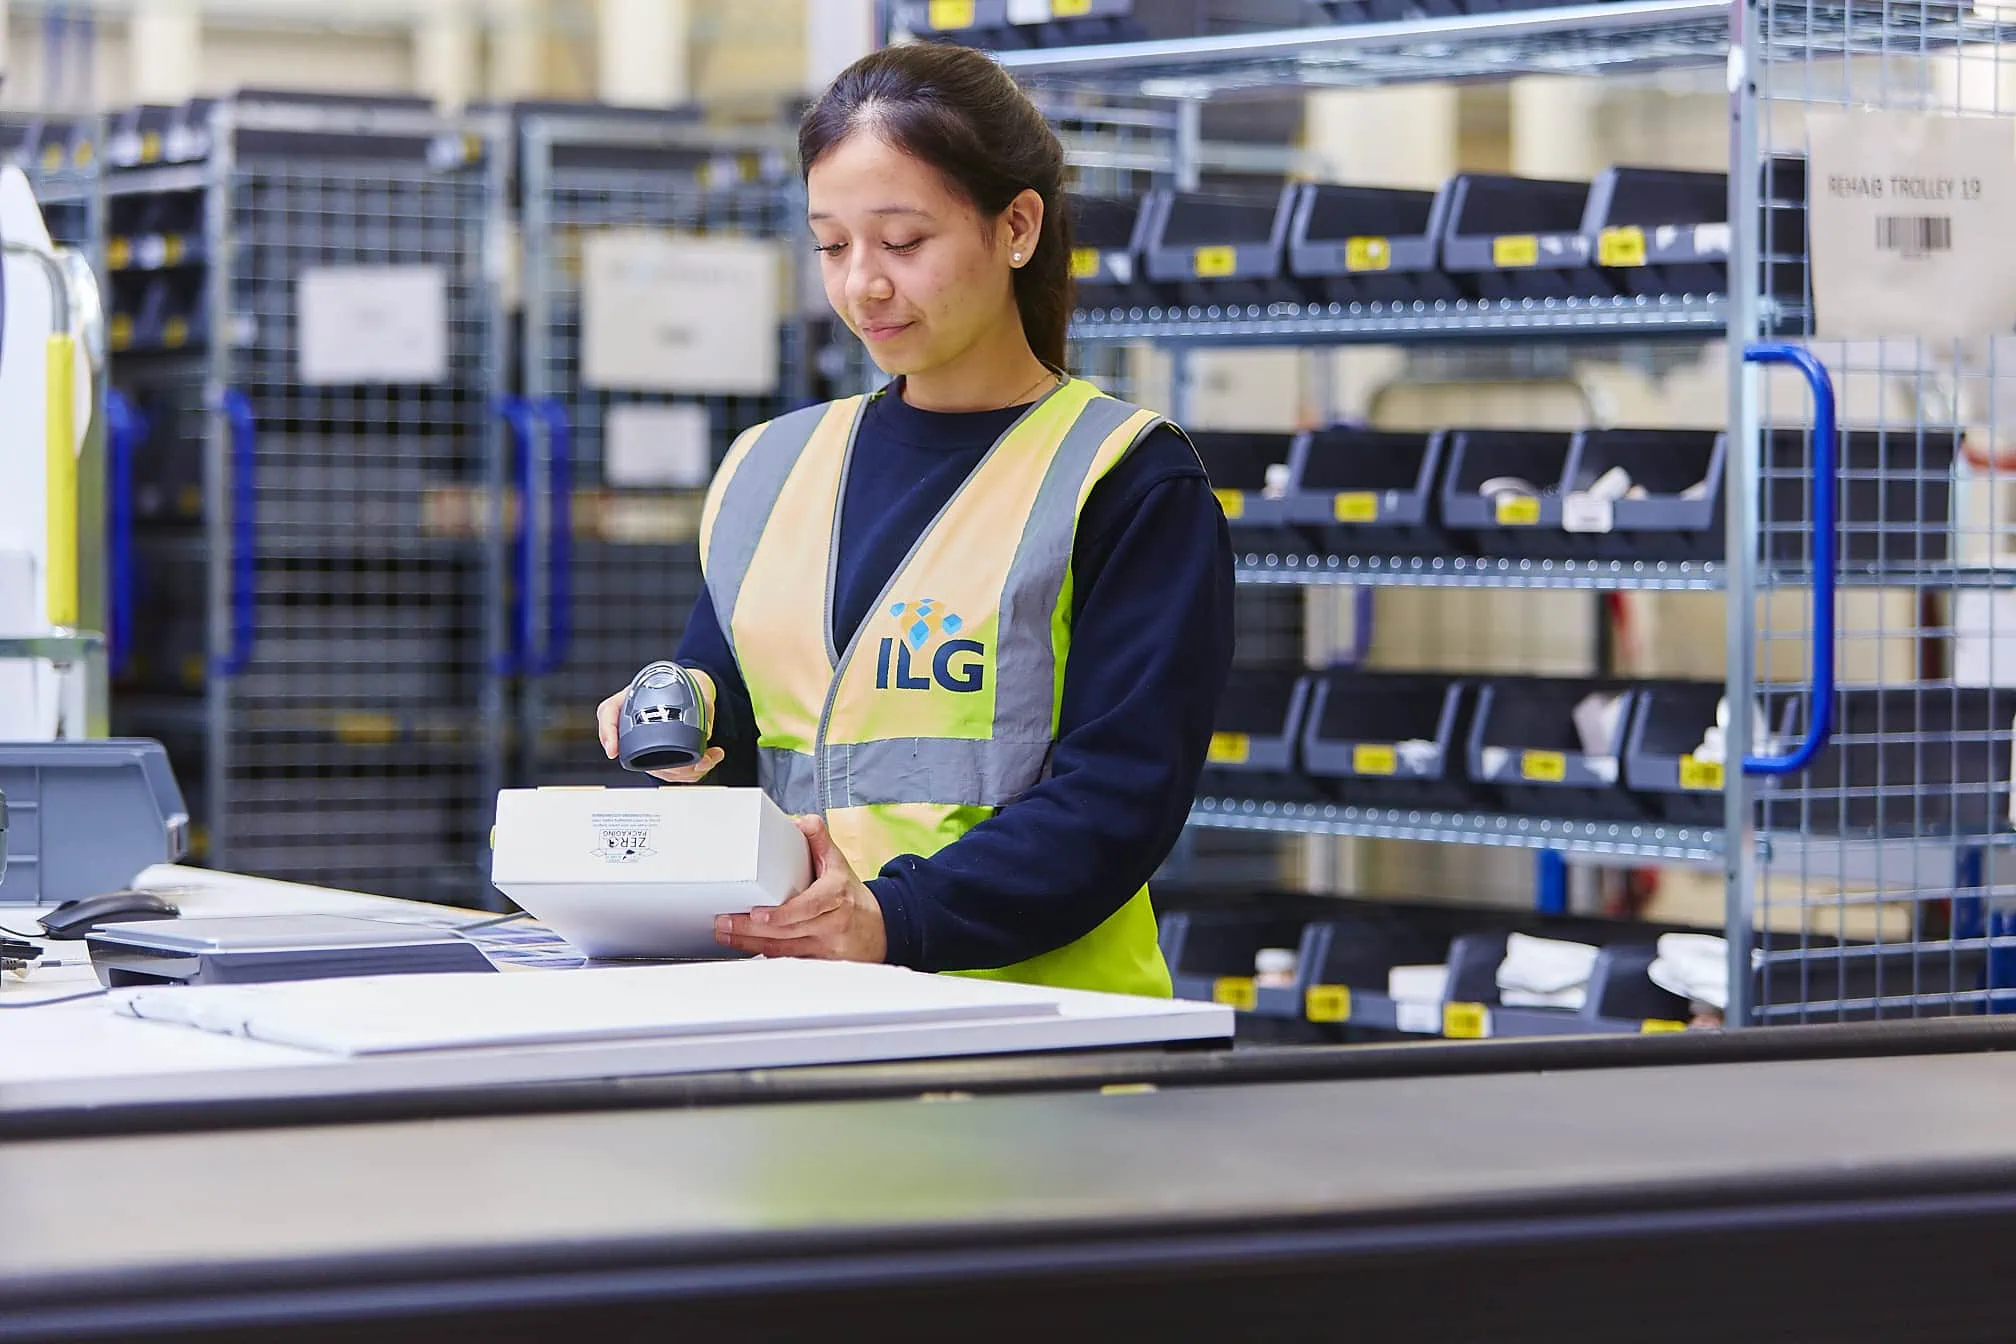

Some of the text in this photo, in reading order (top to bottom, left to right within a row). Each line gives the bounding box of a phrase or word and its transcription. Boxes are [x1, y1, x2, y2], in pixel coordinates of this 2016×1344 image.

[1829, 176, 1981, 199] REHAB TROLLEY 19
[876, 638, 984, 692] ILG
